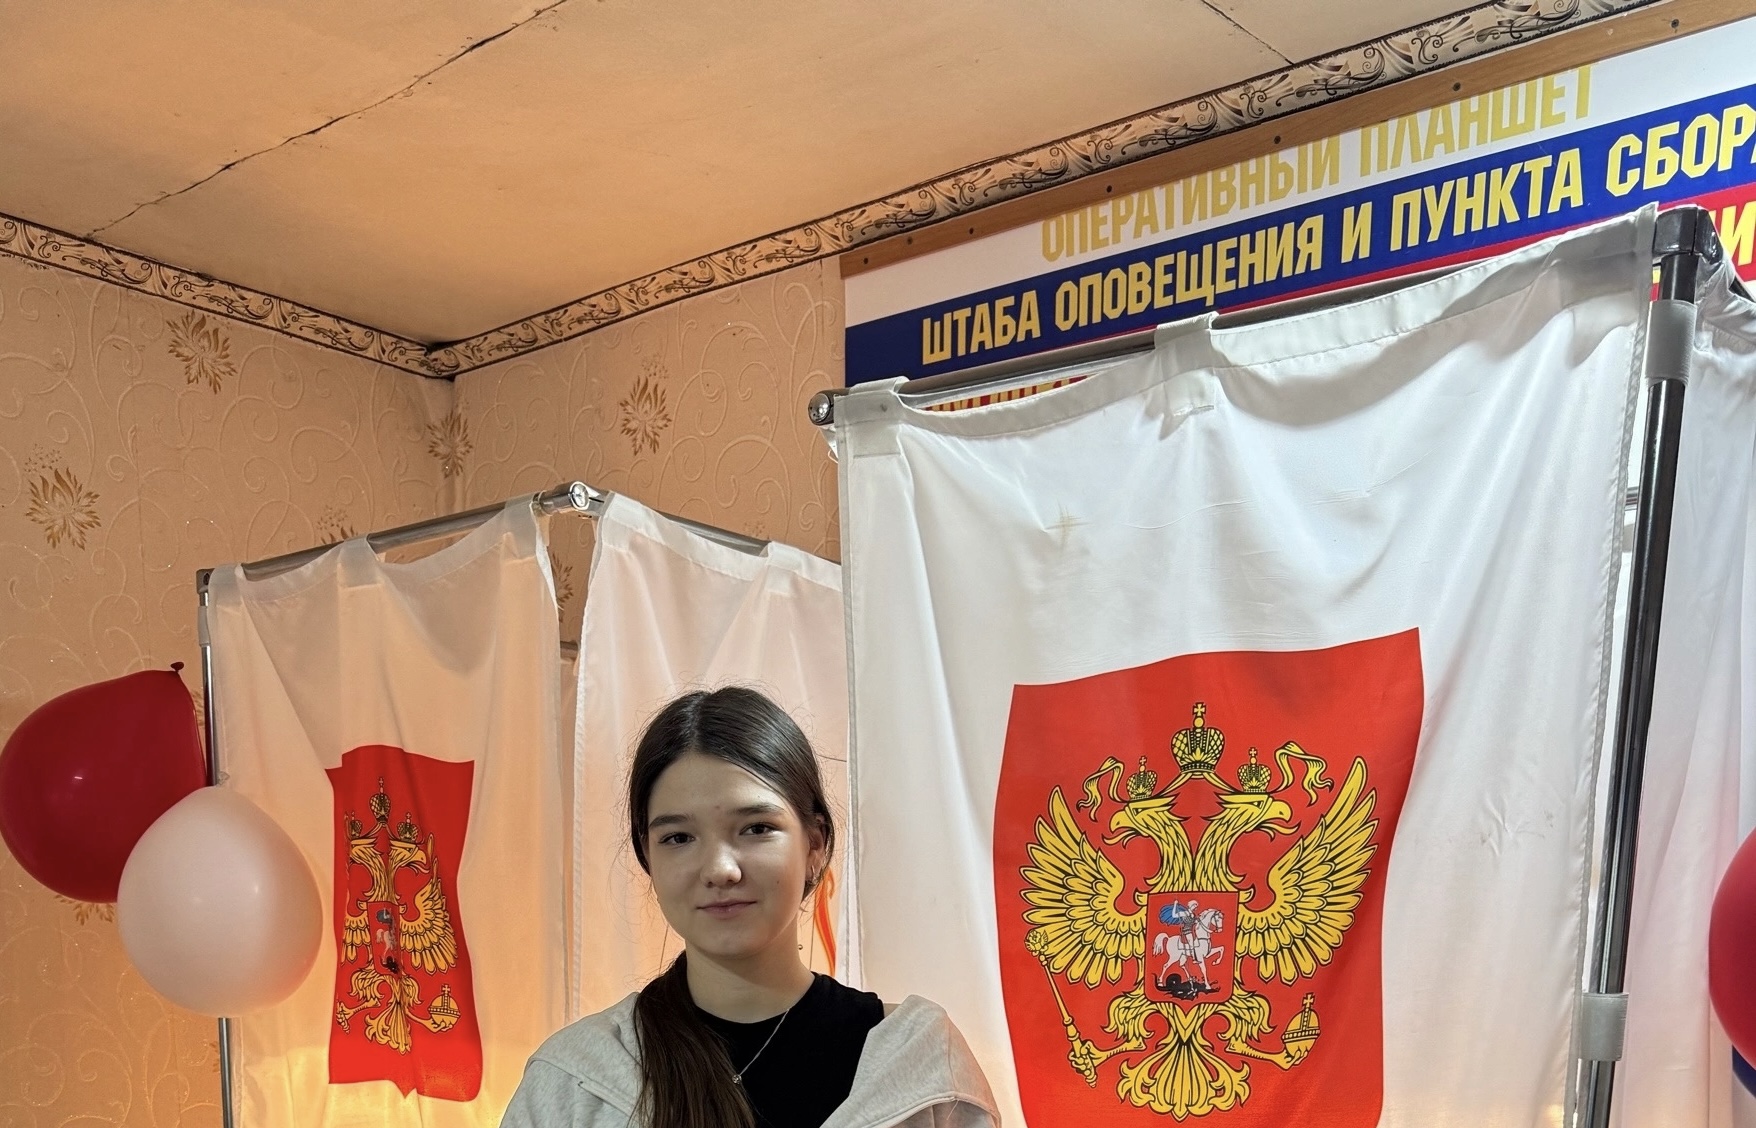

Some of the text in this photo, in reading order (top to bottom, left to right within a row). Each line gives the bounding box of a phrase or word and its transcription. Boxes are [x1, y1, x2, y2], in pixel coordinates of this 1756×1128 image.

[922, 103, 1756, 366] ШТАБА ОПОВЕЩЕНИЯ И ПУНКТА СБОР
